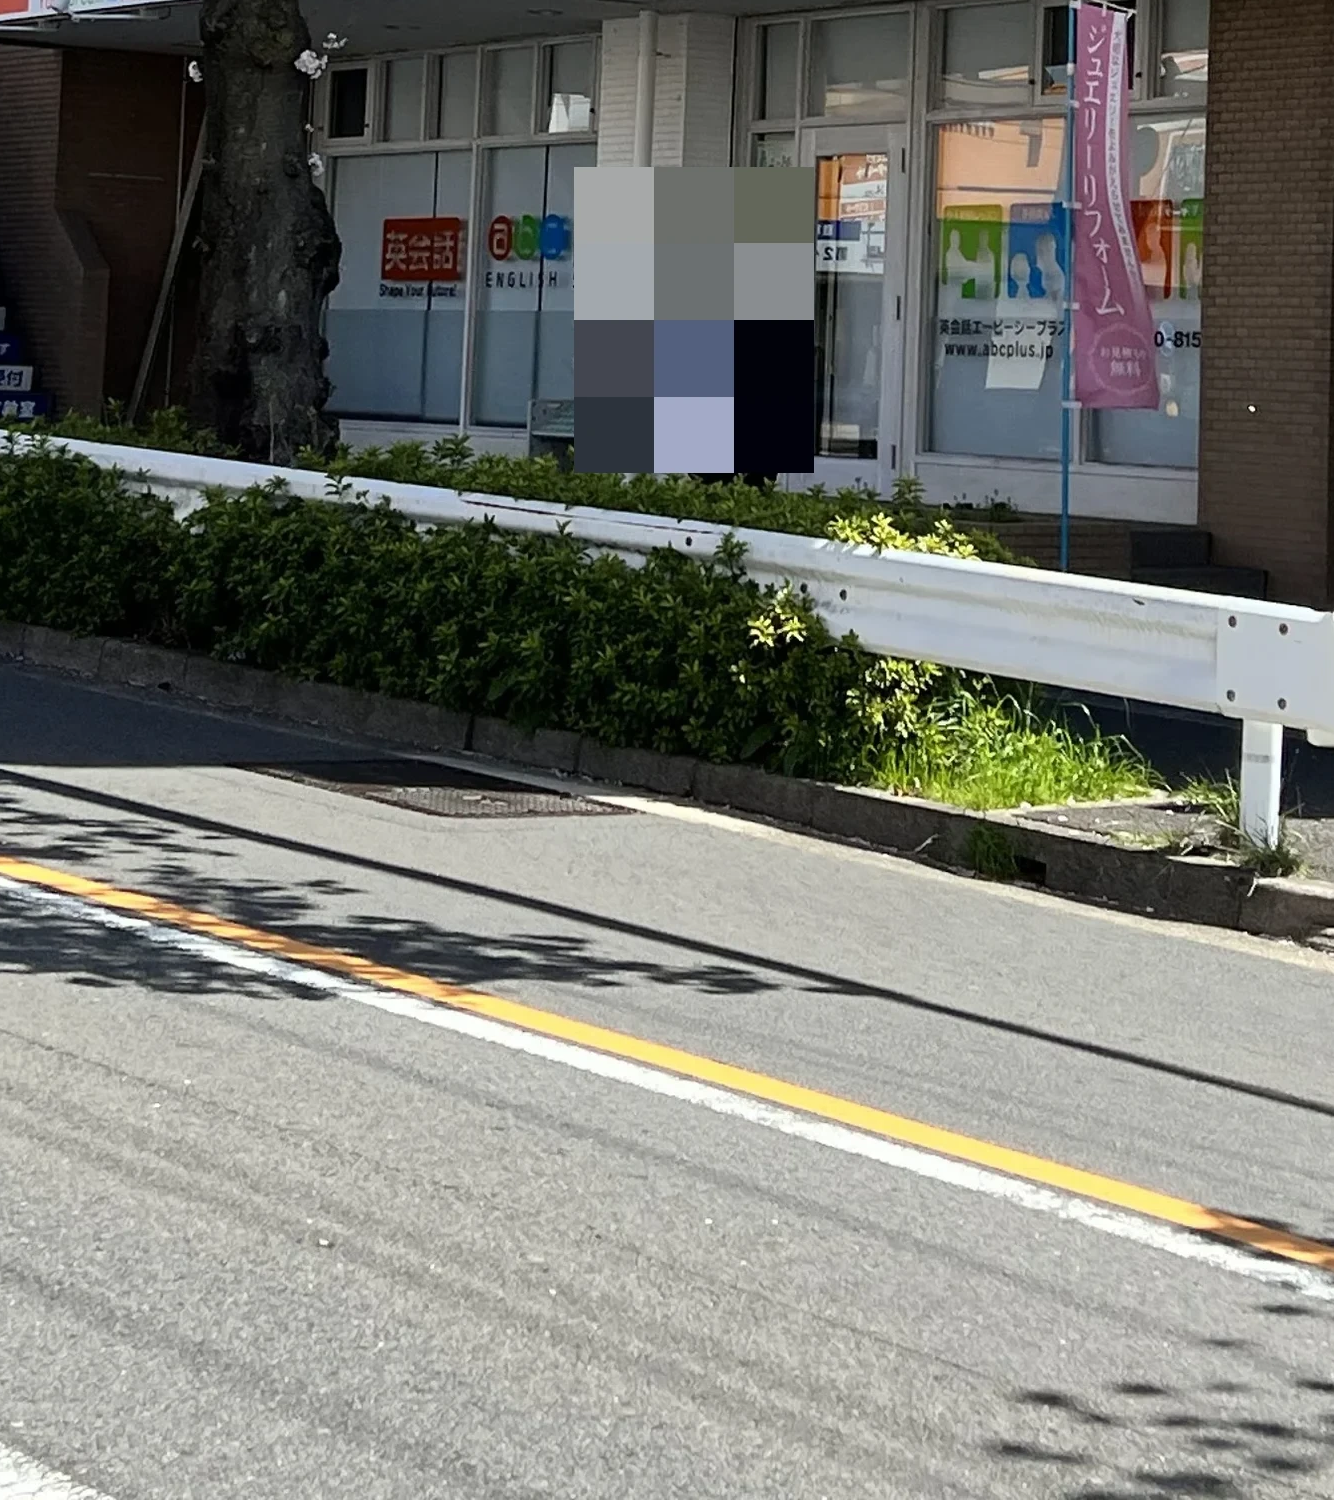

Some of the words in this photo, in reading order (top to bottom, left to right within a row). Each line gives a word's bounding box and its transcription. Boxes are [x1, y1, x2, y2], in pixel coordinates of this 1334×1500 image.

[1082, 24, 1124, 315] ジュエリーリフォーム
[385, 230, 455, 272] 英会話
[944, 340, 1054, 360] www.abcplus.jp
